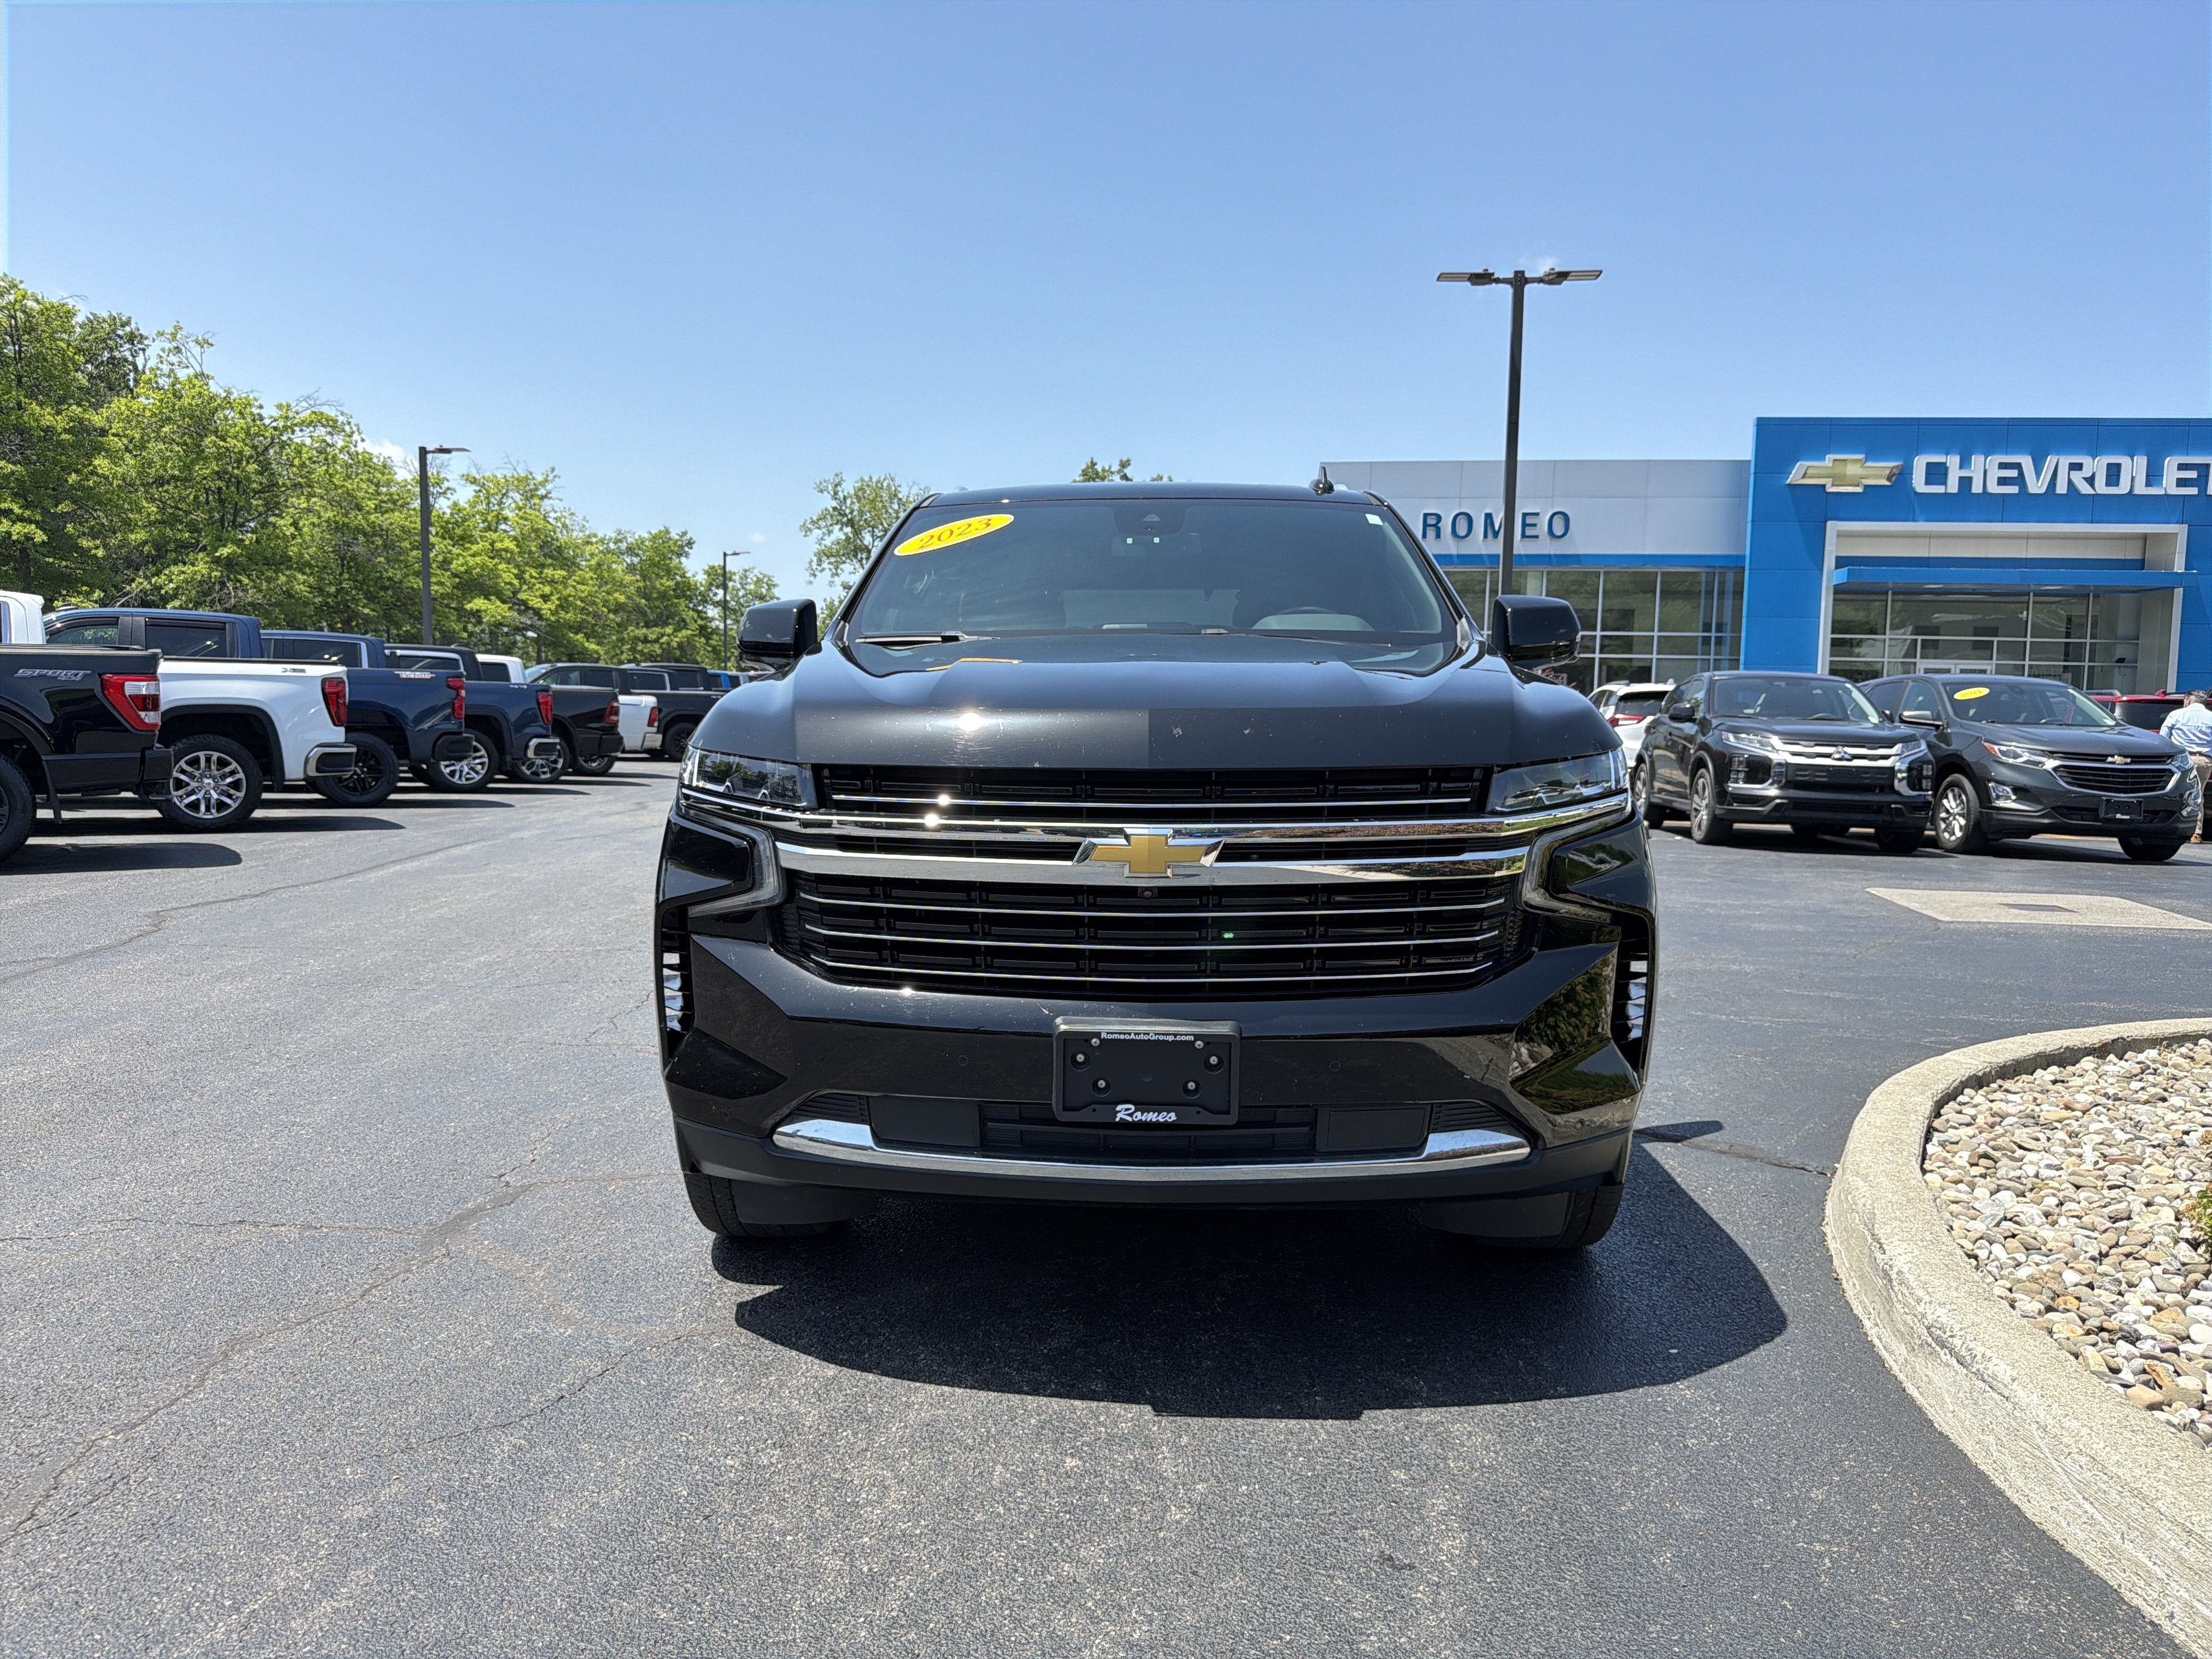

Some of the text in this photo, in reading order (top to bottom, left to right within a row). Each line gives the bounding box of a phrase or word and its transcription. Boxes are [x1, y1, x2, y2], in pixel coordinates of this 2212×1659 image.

[1912, 455, 2212, 495] CHEVROLE
[918, 518, 992, 549] 2023
[1421, 511, 1570, 540] ROMEO
[14, 669, 92, 678] SPORT
[1101, 1032, 1194, 1042] RomeoAutoGroup.com
[1115, 1104, 1177, 1122] Romeo
